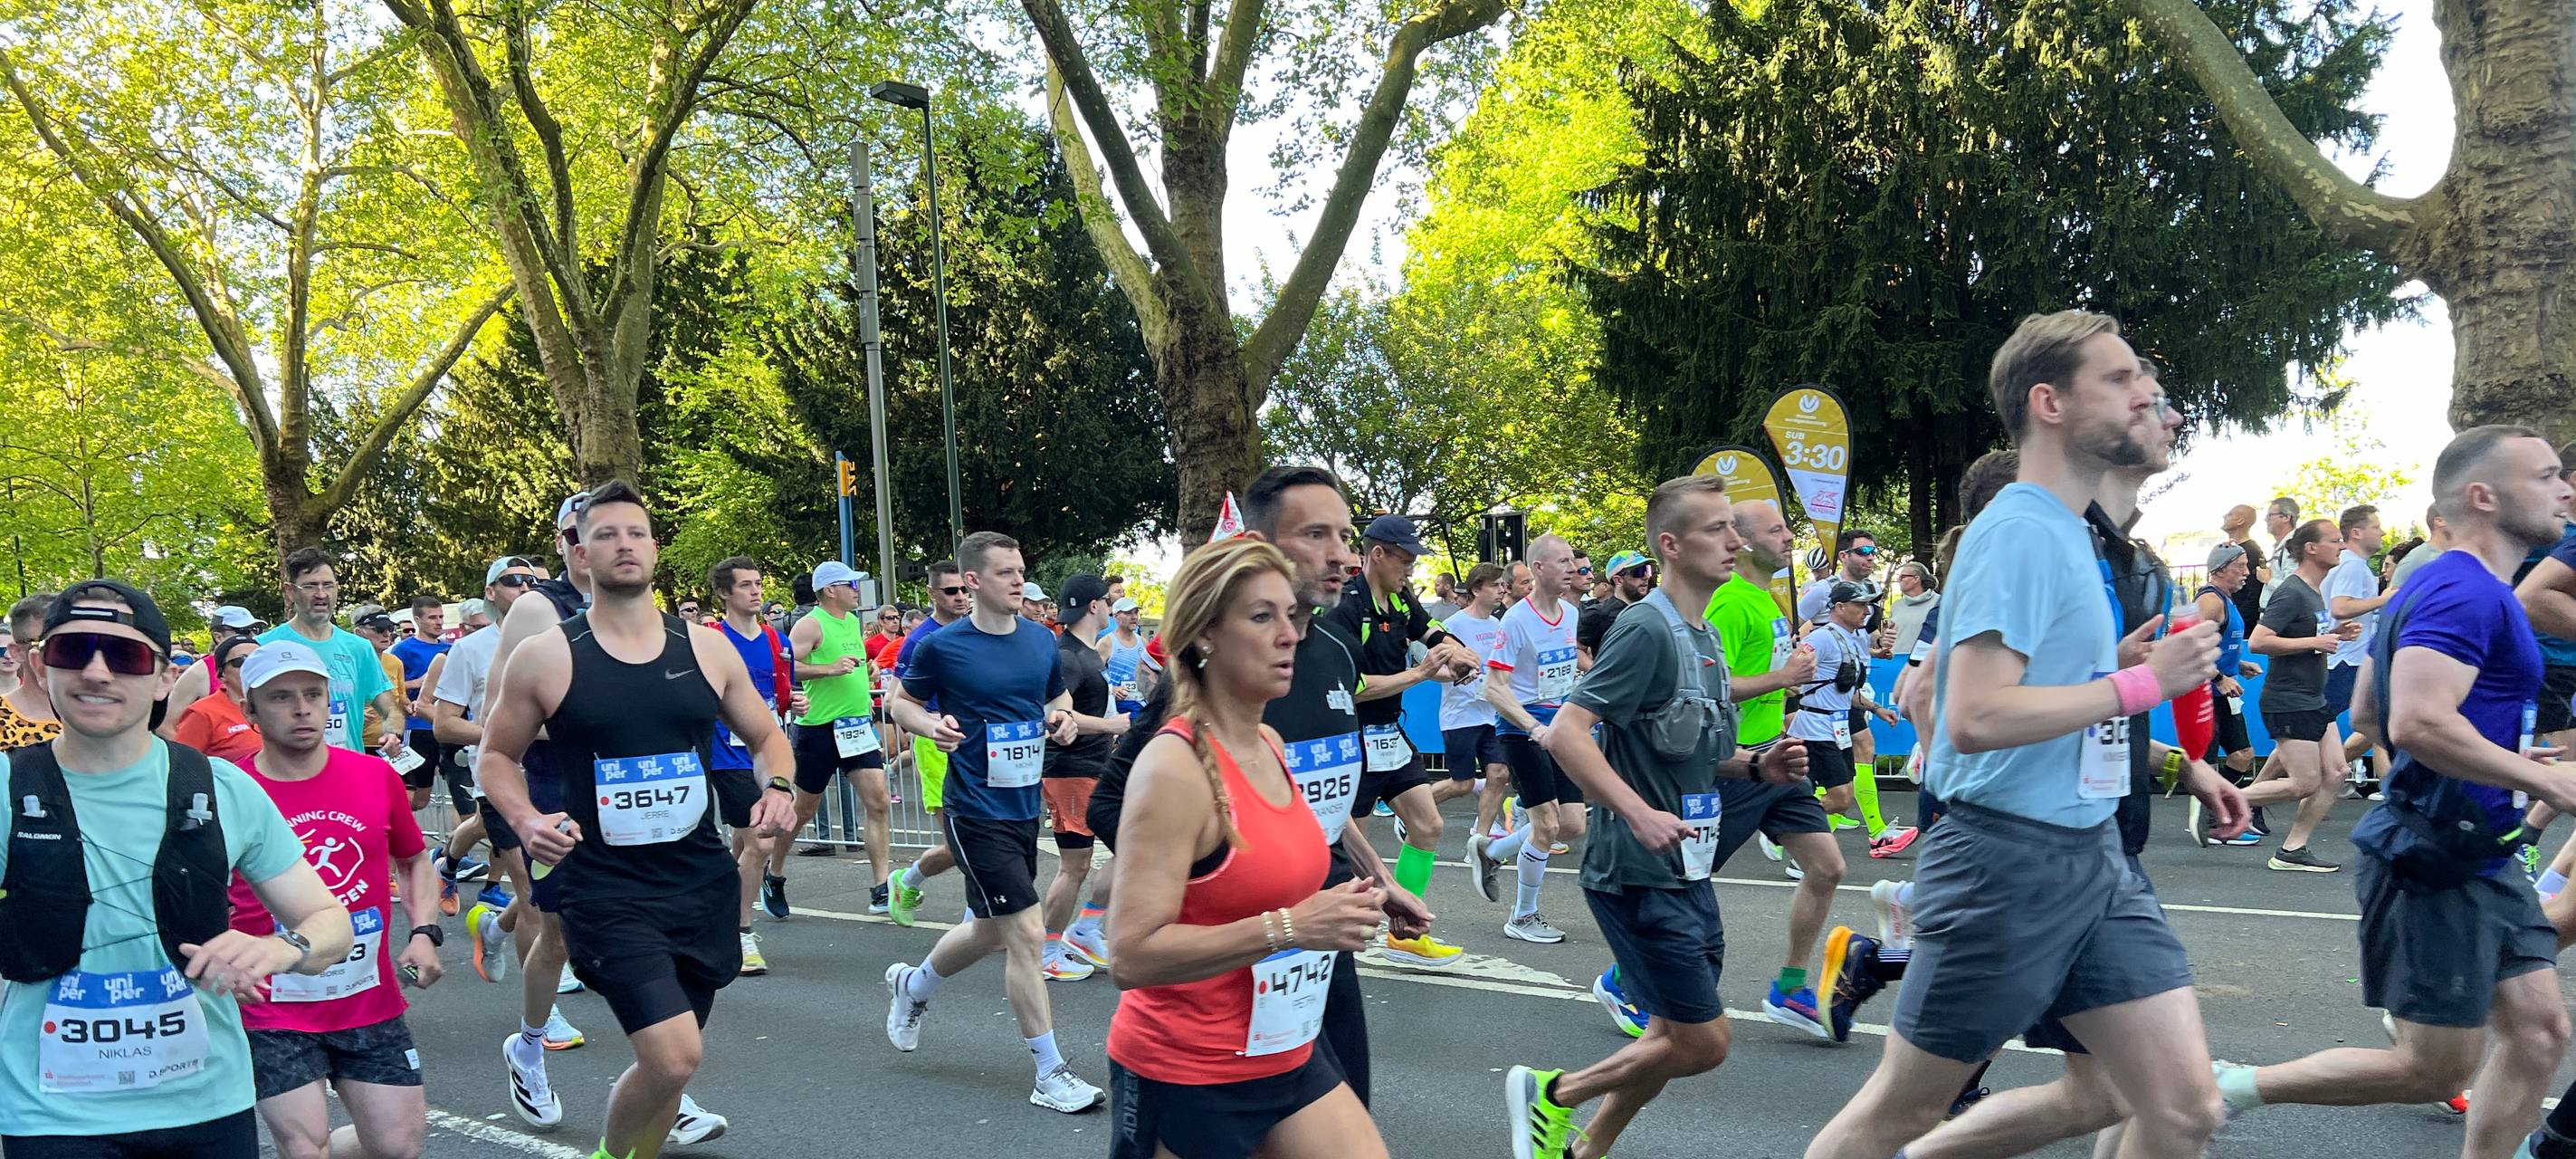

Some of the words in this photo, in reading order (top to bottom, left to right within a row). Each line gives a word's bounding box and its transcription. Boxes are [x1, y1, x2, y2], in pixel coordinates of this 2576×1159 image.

[1785, 430, 1806, 441] SUB
[1784, 441, 1846, 471] 3:30
[840, 728, 865, 740] 1834
[1002, 744, 1040, 761] 1814
[614, 785, 690, 809] 3647
[328, 810, 367, 832] CREW
[17, 831, 62, 840] SALOMON
[336, 878, 369, 906] GEN
[104, 973, 133, 991] uni
[1272, 953, 1331, 996] 4742
[110, 986, 146, 1004] per
[61, 1010, 186, 1043] 3045
[98, 1046, 152, 1059] NIKLAS
